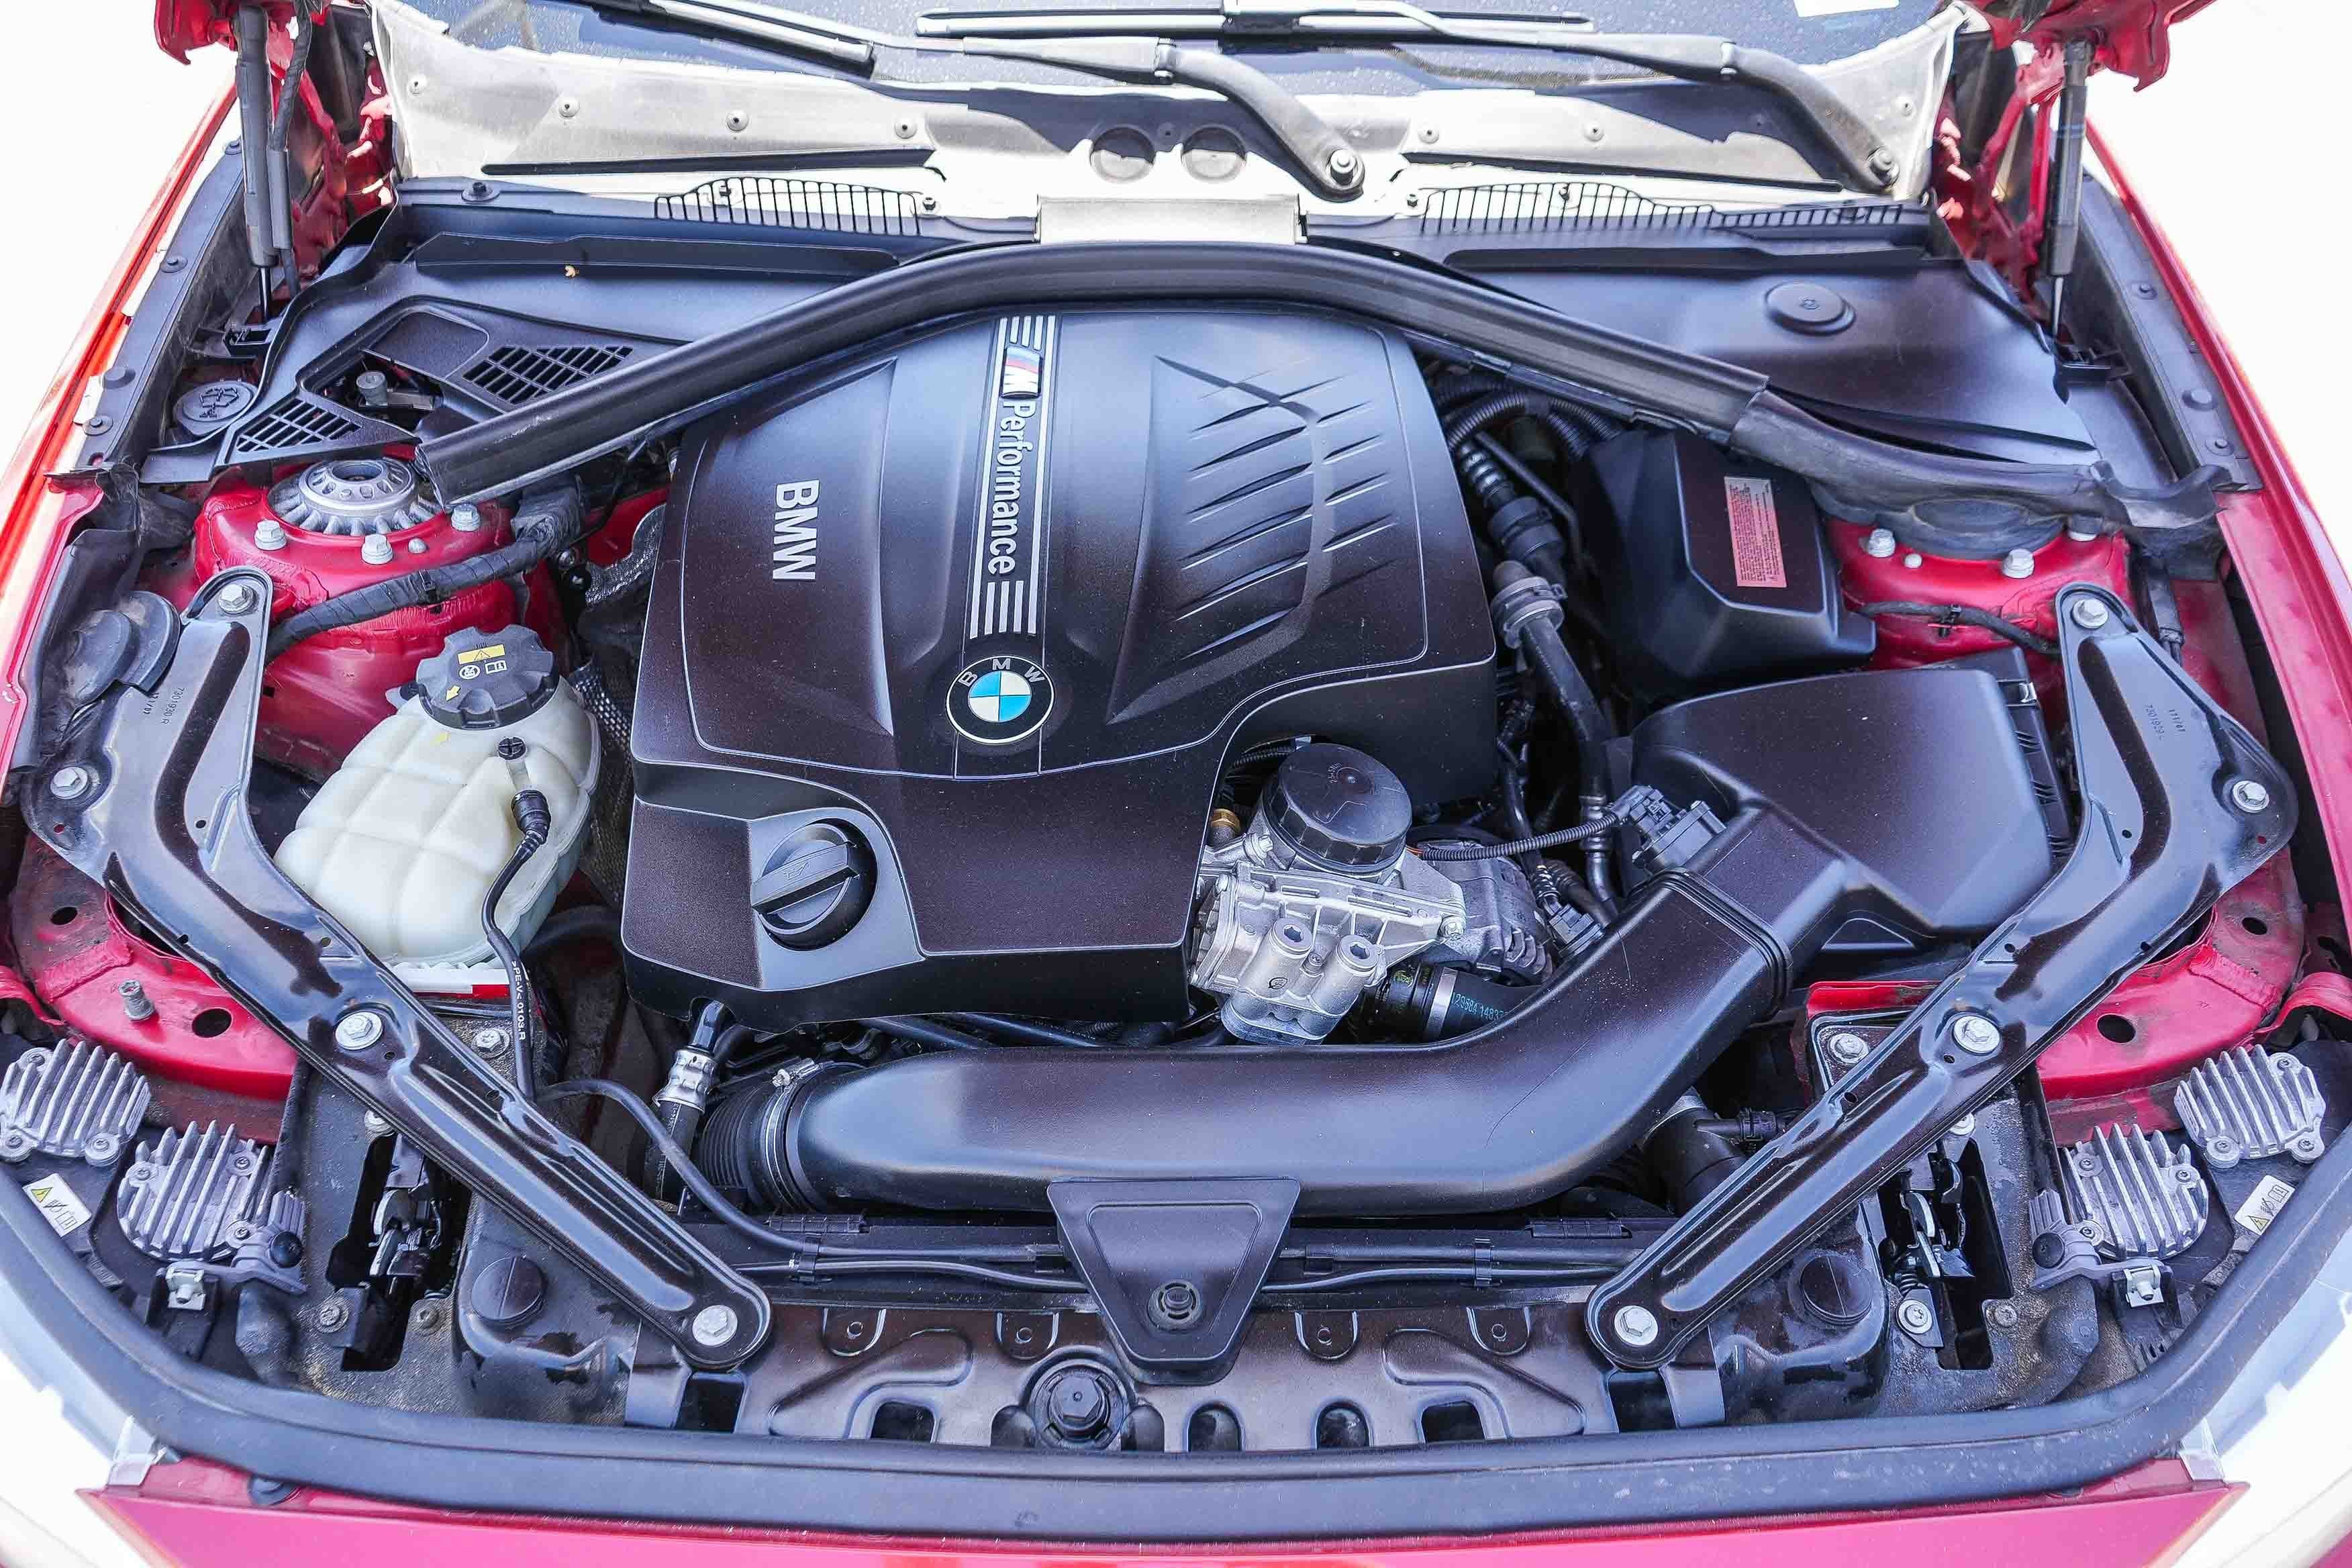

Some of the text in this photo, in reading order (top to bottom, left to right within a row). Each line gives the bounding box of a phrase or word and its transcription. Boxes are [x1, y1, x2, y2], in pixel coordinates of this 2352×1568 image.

[773, 479, 820, 579] BMW
[987, 400, 1036, 576] Performance
[958, 658, 1046, 687] BMW
